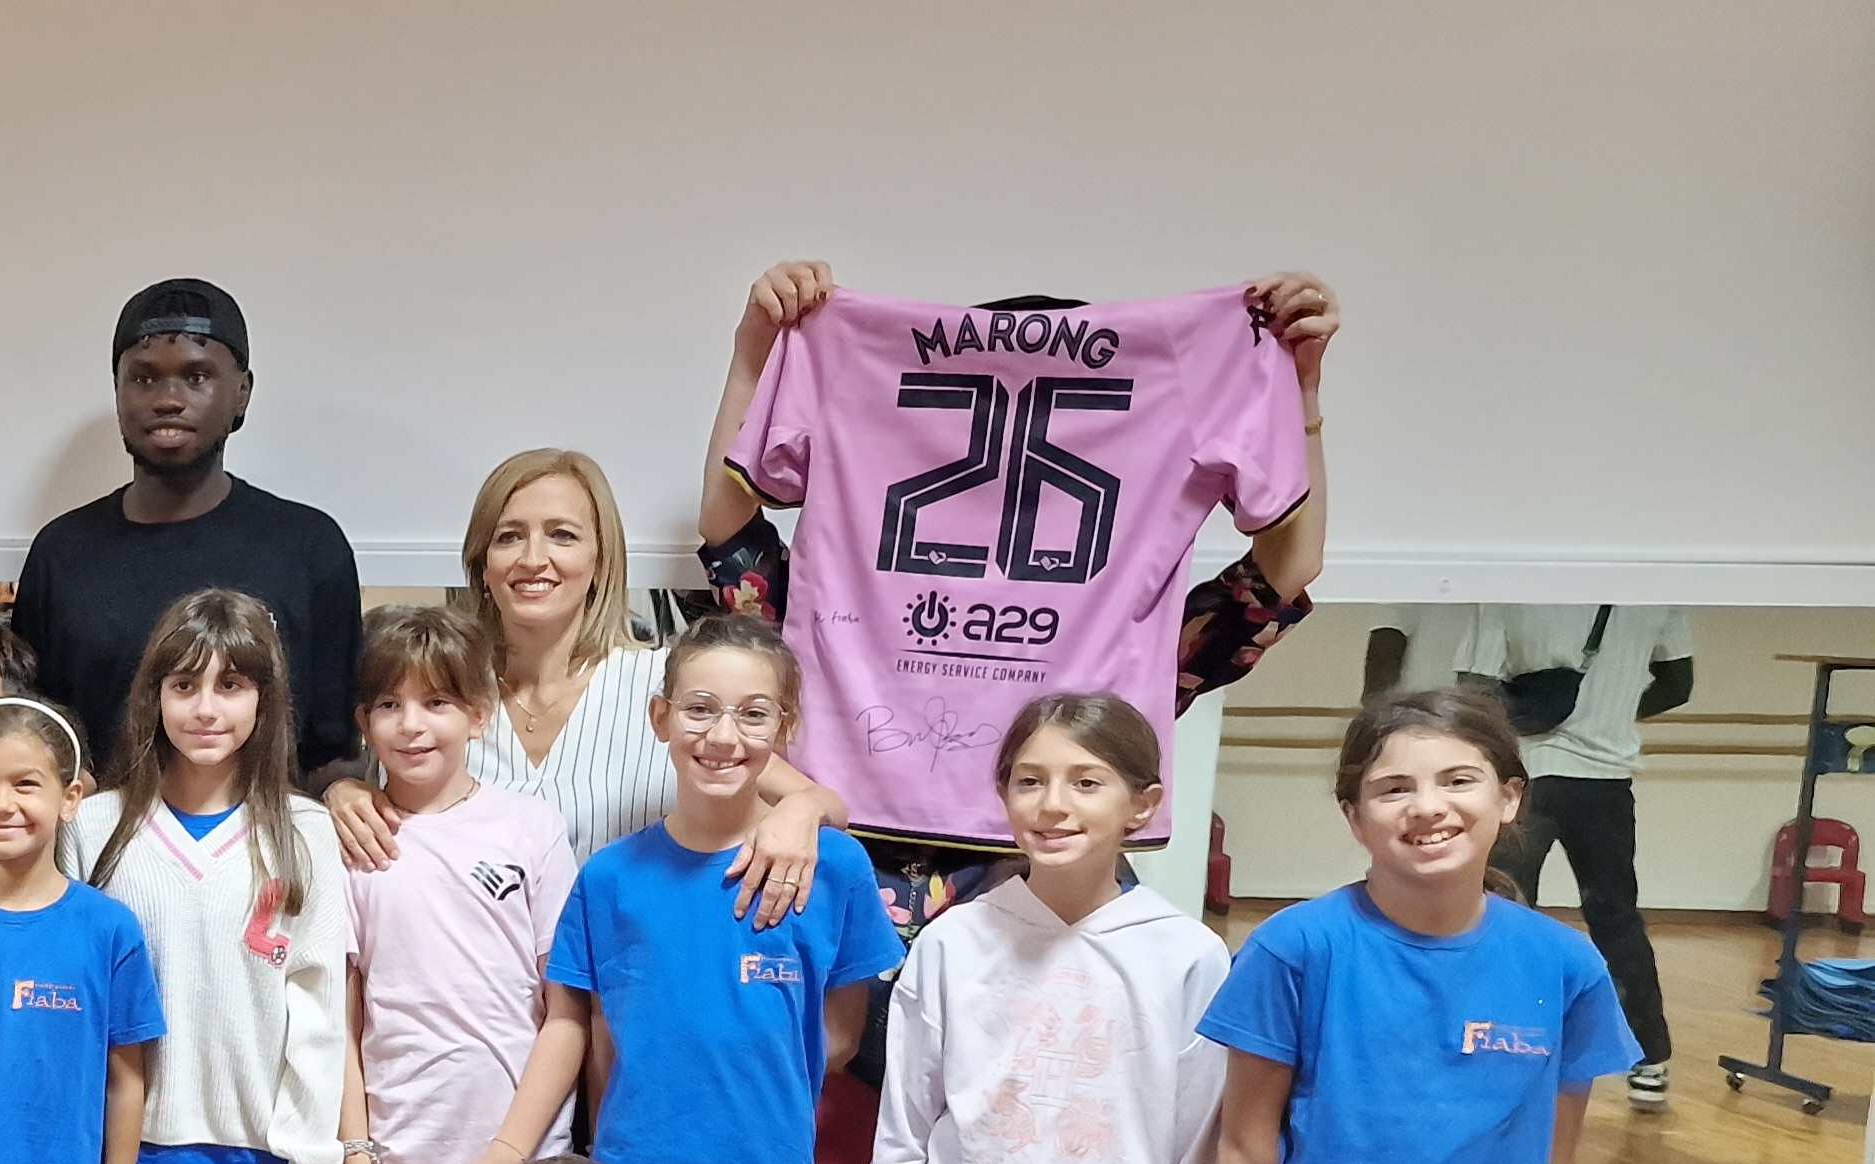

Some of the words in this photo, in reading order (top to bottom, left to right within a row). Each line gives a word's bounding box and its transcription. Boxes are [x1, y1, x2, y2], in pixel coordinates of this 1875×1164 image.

[911, 312, 1120, 369] MARONG
[876, 372, 1134, 584] 26
[963, 603, 1060, 645] a29
[896, 659, 937, 675] ENERGY
[941, 663, 988, 680] SERVICE
[992, 667, 1046, 683] COMPANY
[12, 980, 83, 1011] Fiaba
